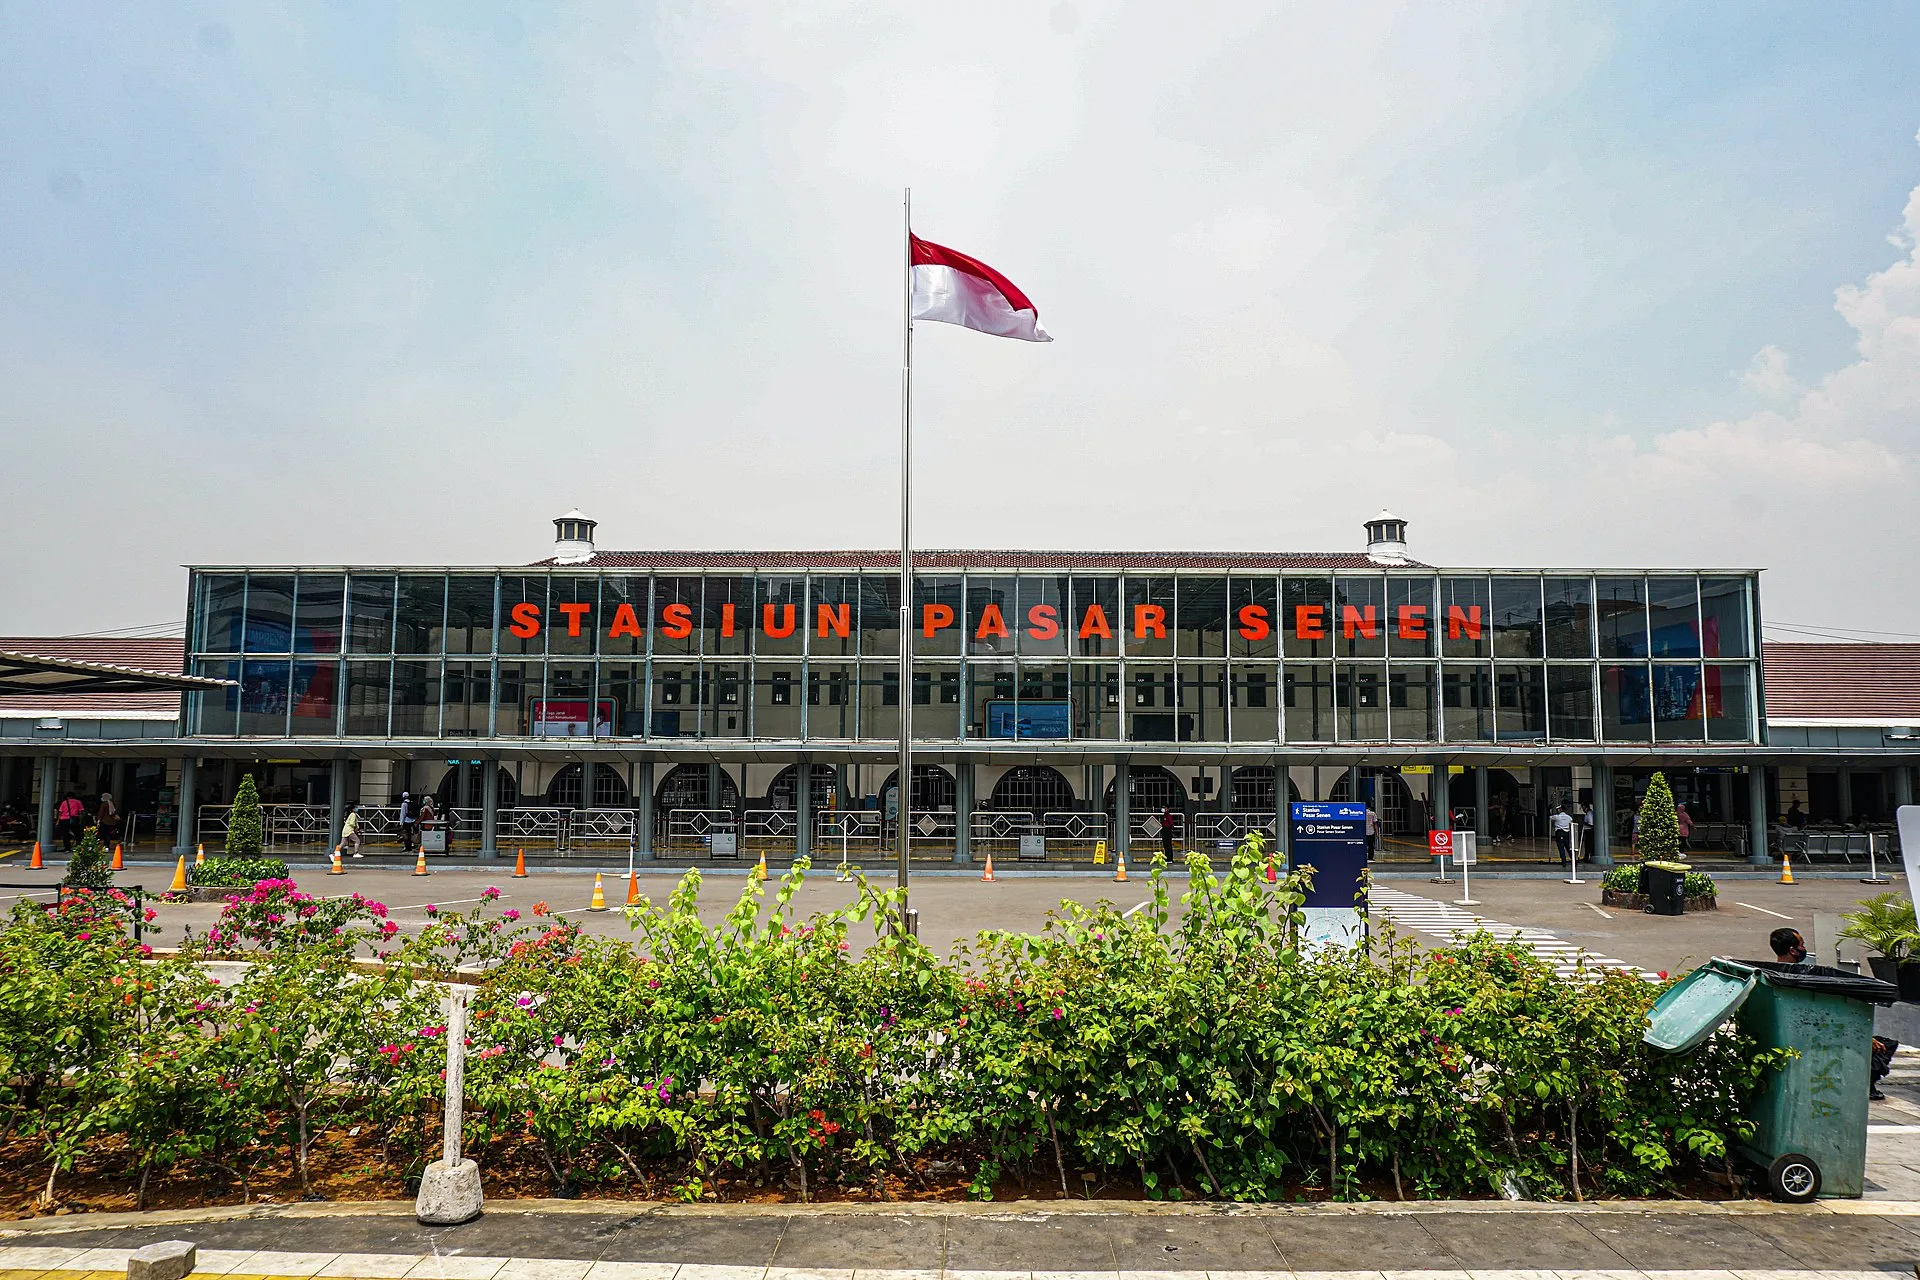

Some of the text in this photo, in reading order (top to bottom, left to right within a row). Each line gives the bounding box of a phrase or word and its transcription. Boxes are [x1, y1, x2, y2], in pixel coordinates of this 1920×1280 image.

[509, 602, 1481, 641] STASIUN PASAR SENEN
